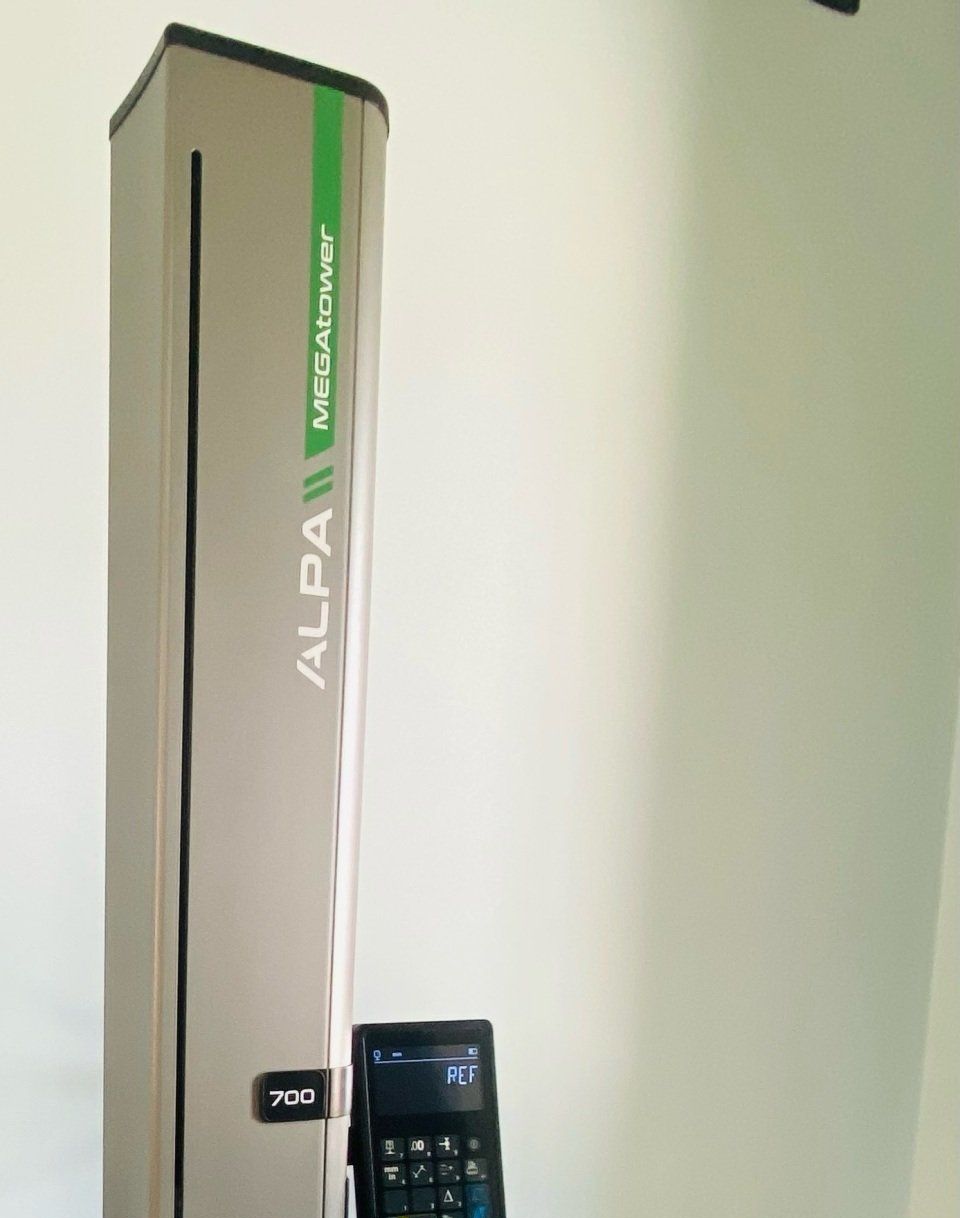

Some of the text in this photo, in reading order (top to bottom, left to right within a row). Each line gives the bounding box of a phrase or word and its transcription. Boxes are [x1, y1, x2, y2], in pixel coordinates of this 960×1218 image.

[296, 224, 335, 690] ALPA MEGAtower
[447, 1065, 478, 1085] REF
[269, 1088, 315, 1107] 700
